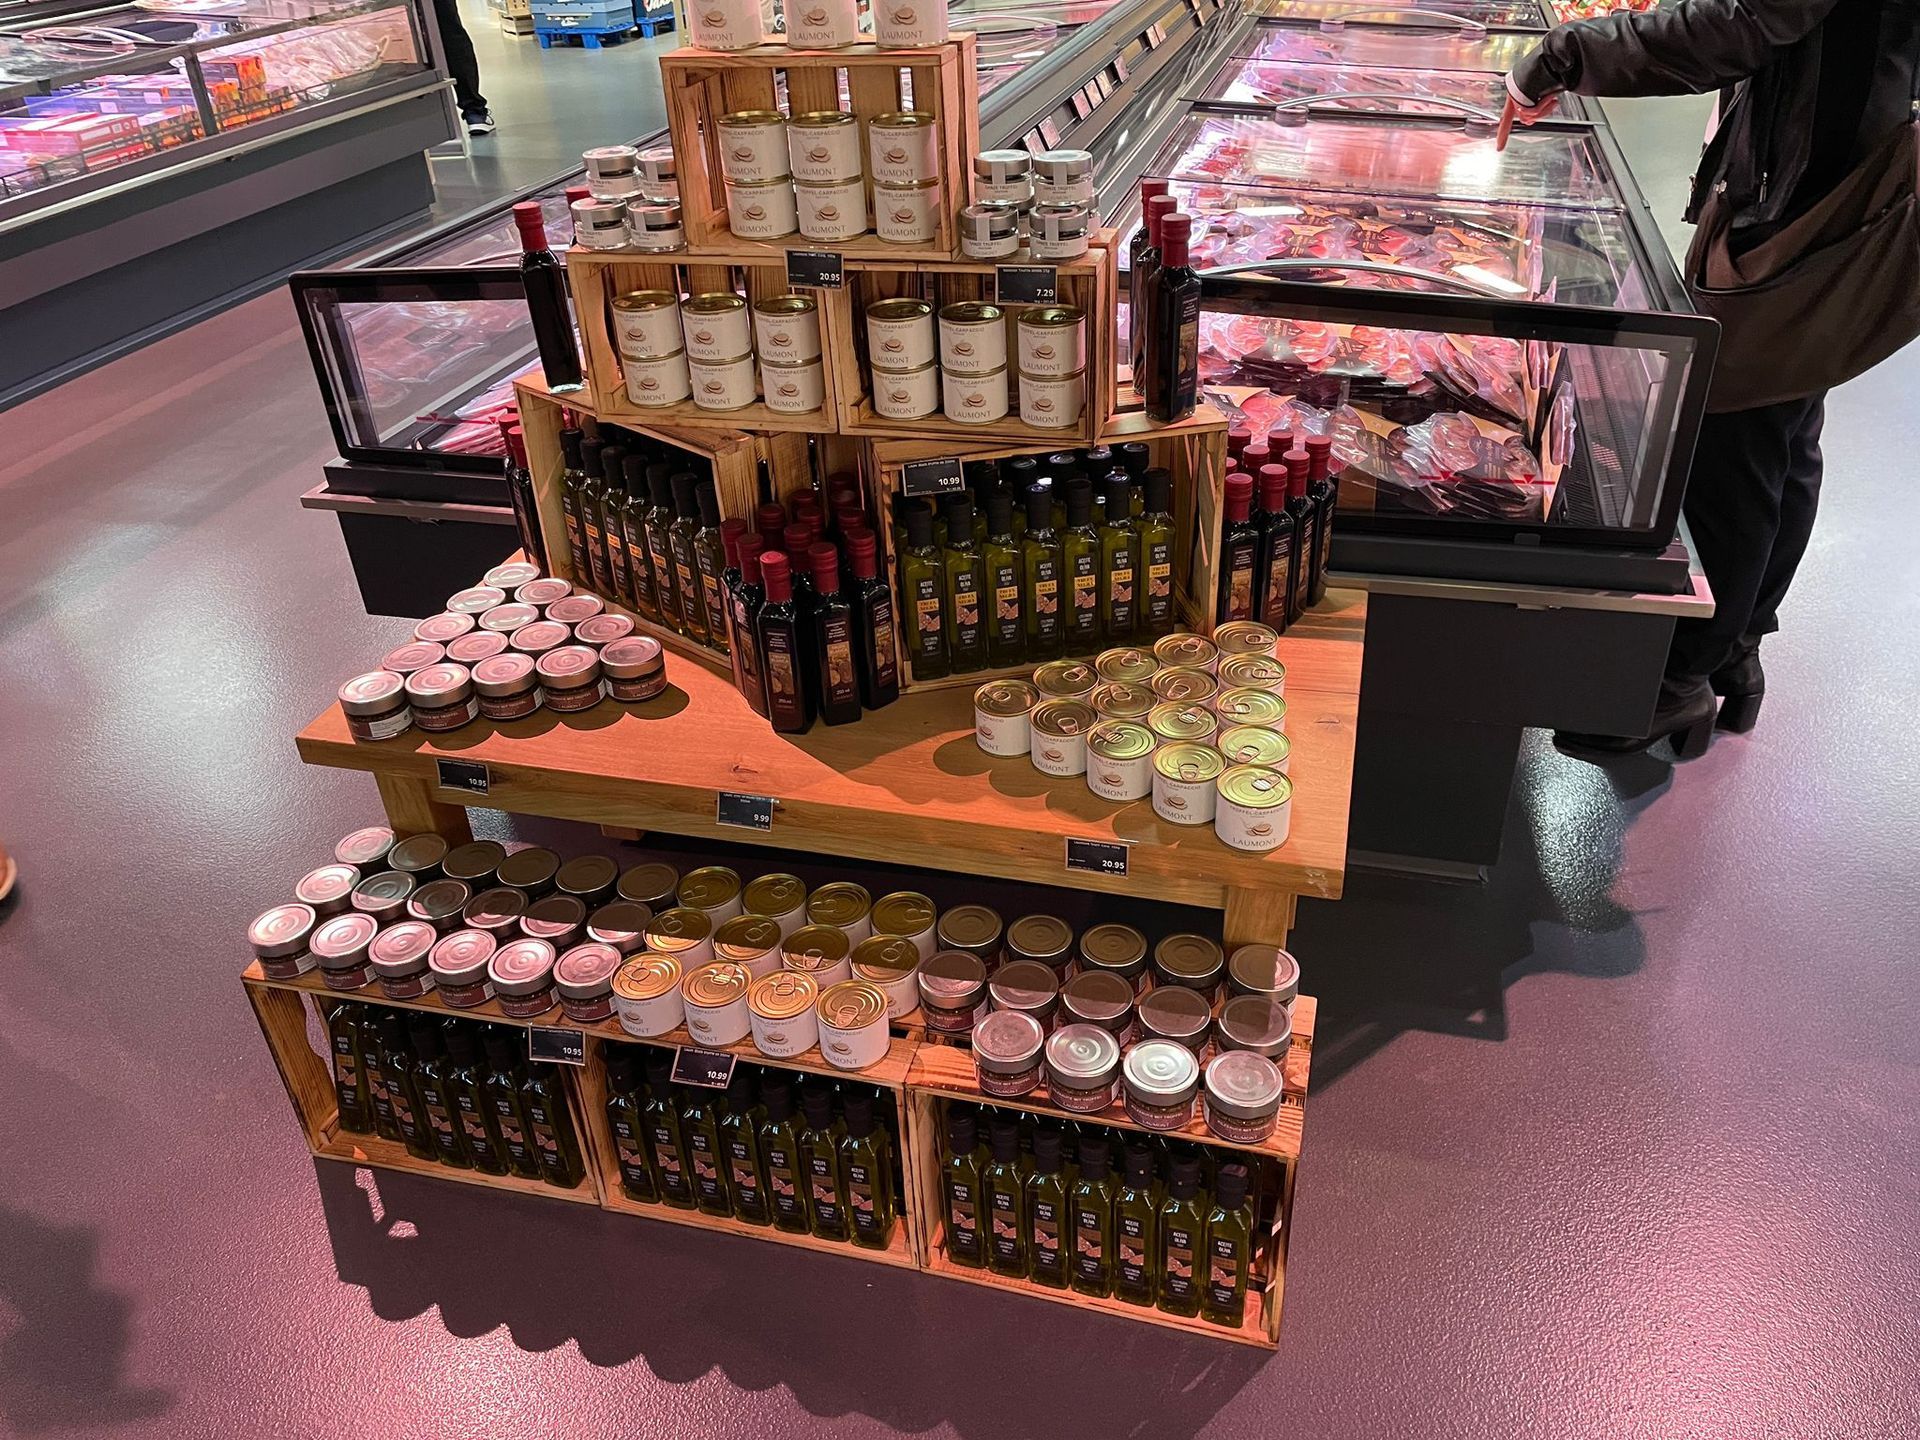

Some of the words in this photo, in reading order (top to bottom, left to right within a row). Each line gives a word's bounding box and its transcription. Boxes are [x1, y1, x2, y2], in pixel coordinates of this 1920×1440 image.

[696, 31, 734, 42] LAUMONT
[794, 31, 835, 41] LAUMONT
[882, 30, 923, 41] LAUMONT
[798, 167, 836, 176] LAUMONT
[876, 168, 914, 176] LAUMONT
[806, 225, 846, 234] LAUMONT
[883, 228, 921, 236] LAUMONT
[819, 272, 841, 282] 20.95
[1036, 288, 1054, 298] 7.29
[873, 355, 911, 364] LAUMONT
[1023, 362, 1061, 371] LAUMONT
[769, 399, 805, 408] LAUMONT
[879, 406, 917, 415] LAUMONT
[953, 409, 991, 418] LAUMONT
[1023, 413, 1060, 423] LAUMONT
[938, 477, 960, 486] 10.99
[468, 778, 487, 787] 10.95
[753, 814, 770, 823] 9.99
[1233, 838, 1277, 847] LAUMONT
[1102, 859, 1125, 870] 20.95
[563, 1047, 582, 1056] 10.95
[707, 1070, 728, 1081] 10.99
